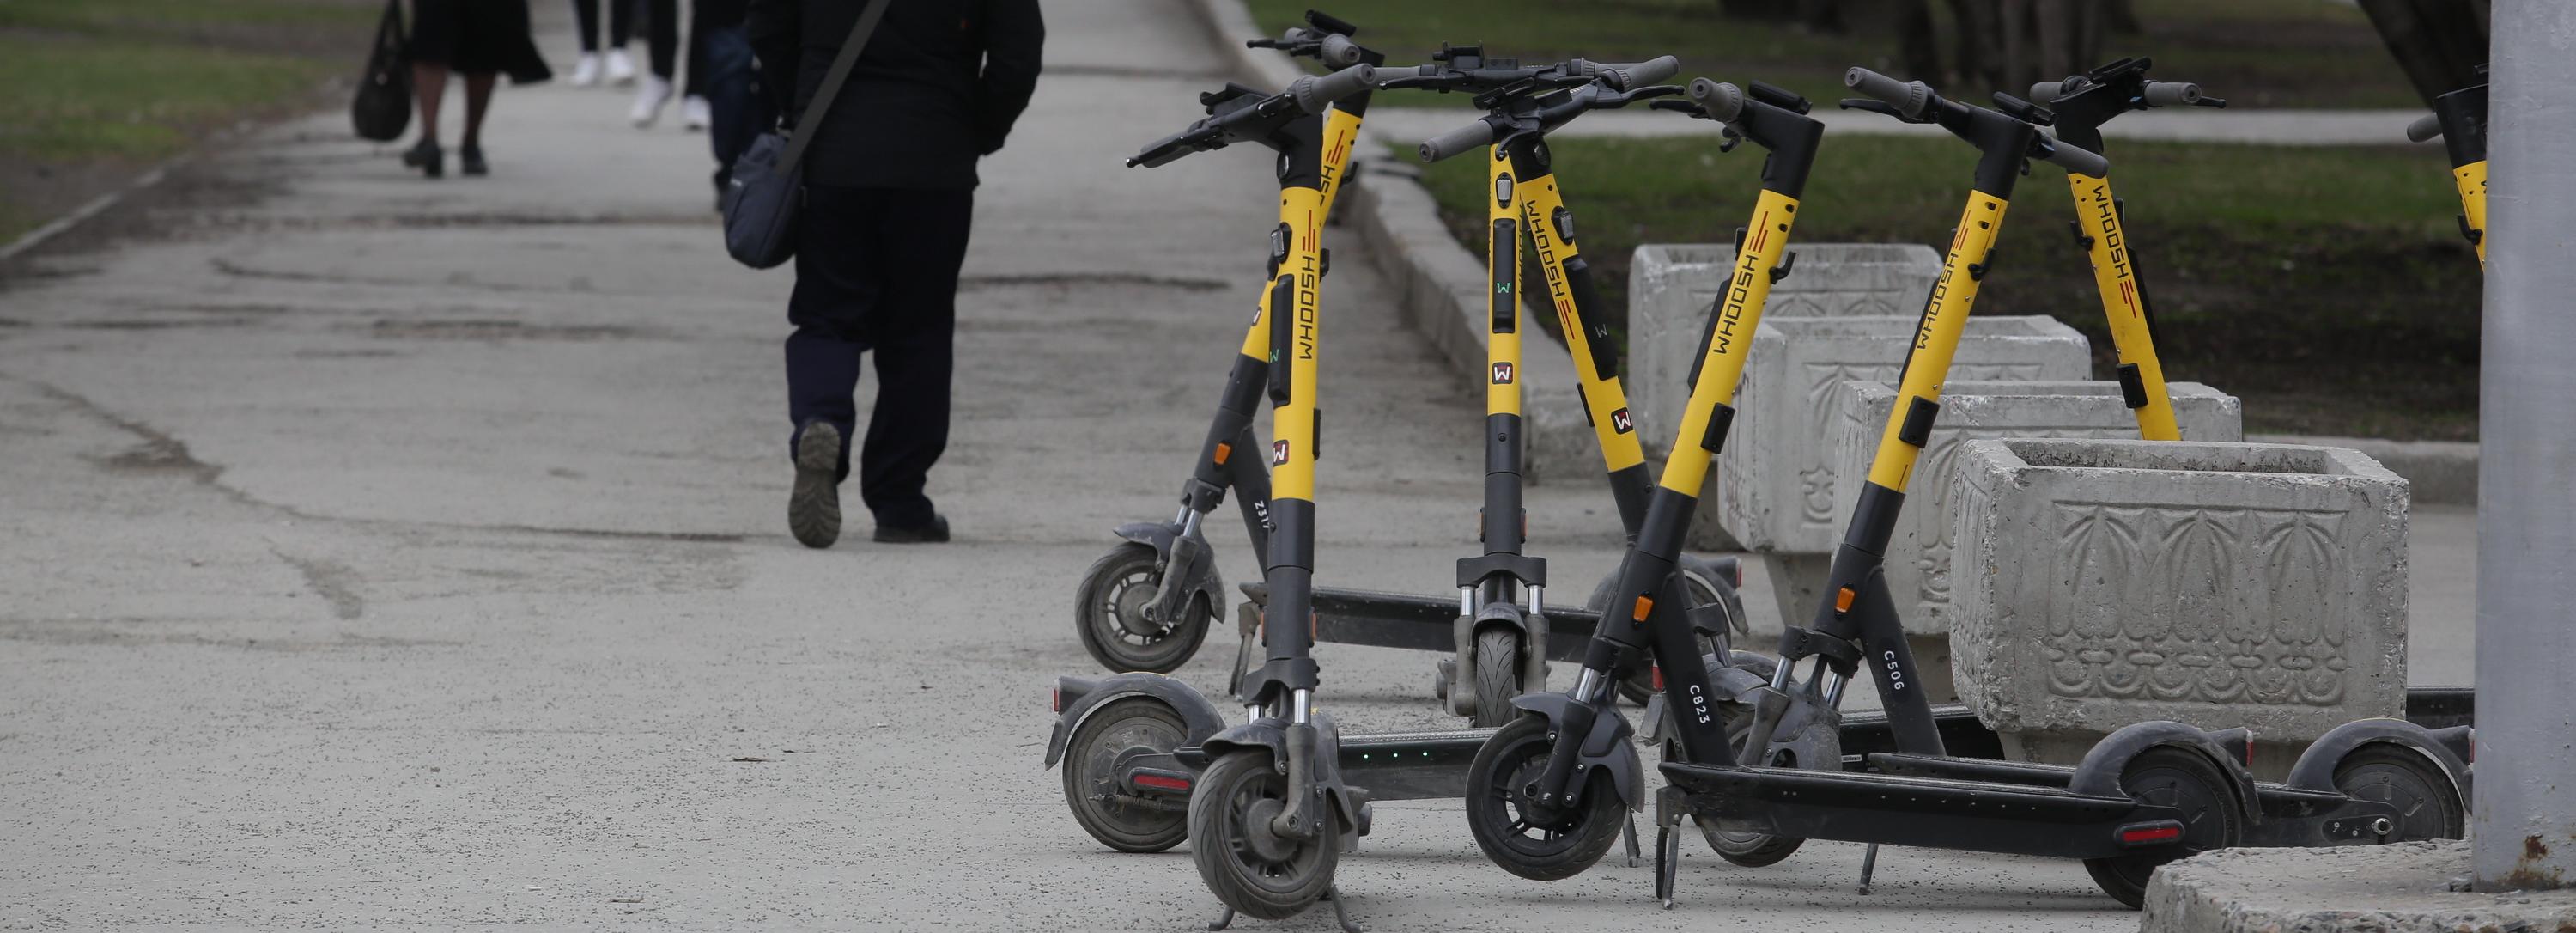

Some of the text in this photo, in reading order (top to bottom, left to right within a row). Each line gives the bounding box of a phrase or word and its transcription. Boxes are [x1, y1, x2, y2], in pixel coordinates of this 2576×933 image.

[1526, 199, 1566, 297] WHOOSH
[2093, 185, 2129, 279] WHOOSH
[1299, 255, 1315, 360] WHOOSH
[1497, 282, 1511, 294] W
[1712, 254, 1759, 355] WHOOSH
[1917, 253, 1959, 350] WHOOSH
[1595, 323, 1608, 338] W
[1269, 348, 1280, 364] W
[1493, 365, 1511, 381] W
[1614, 411, 1631, 430] W
[1273, 443, 1286, 463] W
[1884, 650, 1905, 690] C506
[1689, 684, 1710, 723] C823
